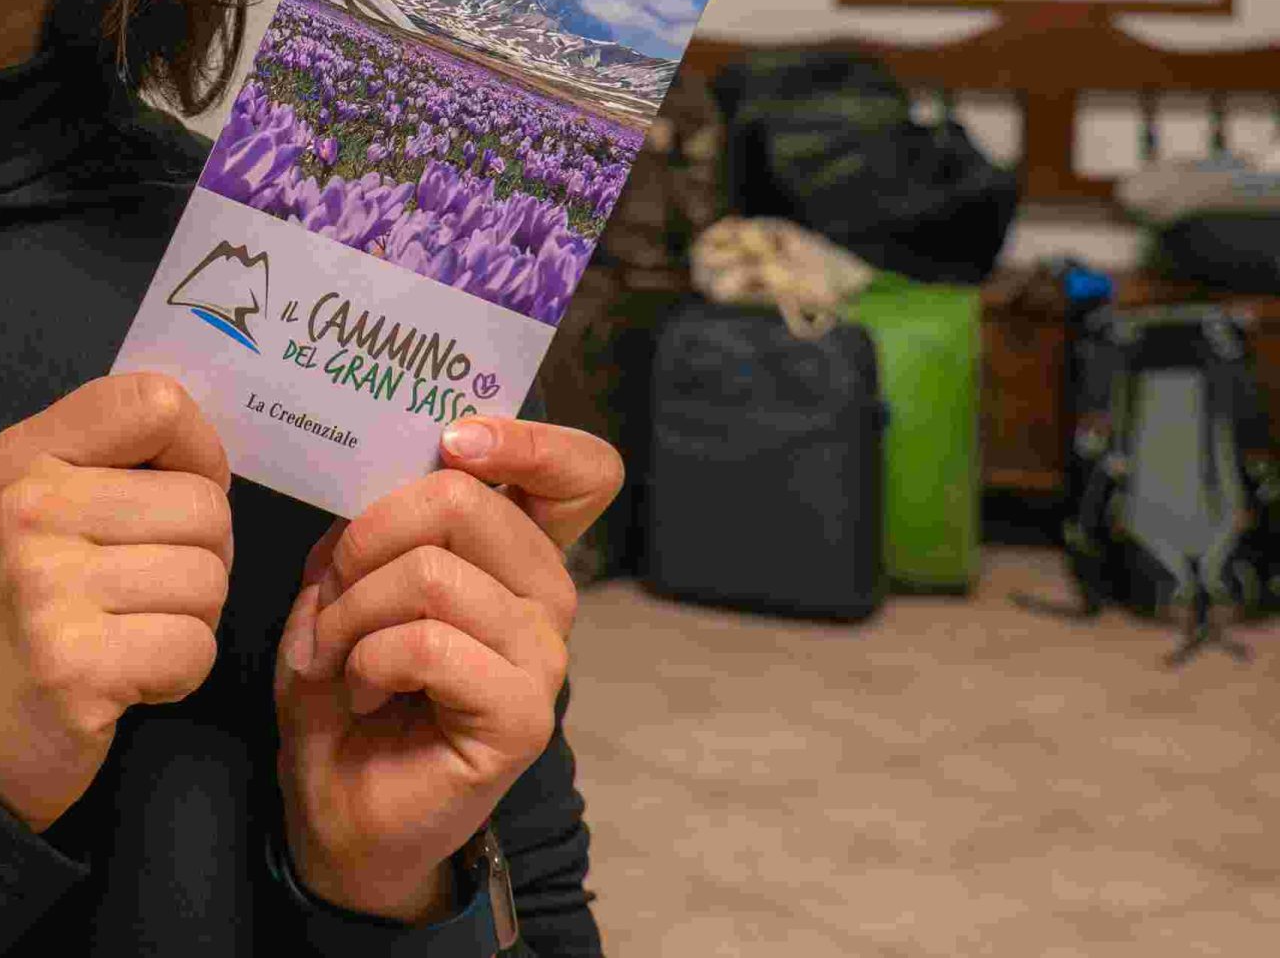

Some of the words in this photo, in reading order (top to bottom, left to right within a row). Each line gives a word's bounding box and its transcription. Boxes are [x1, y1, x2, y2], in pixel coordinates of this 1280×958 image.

[280, 300, 299, 323] IL
[307, 291, 472, 382] CAMMINO
[282, 339, 318, 369] DEL
[323, 348, 405, 402] GRAN
[245, 391, 266, 414] La
[268, 401, 359, 450] Credenziale
